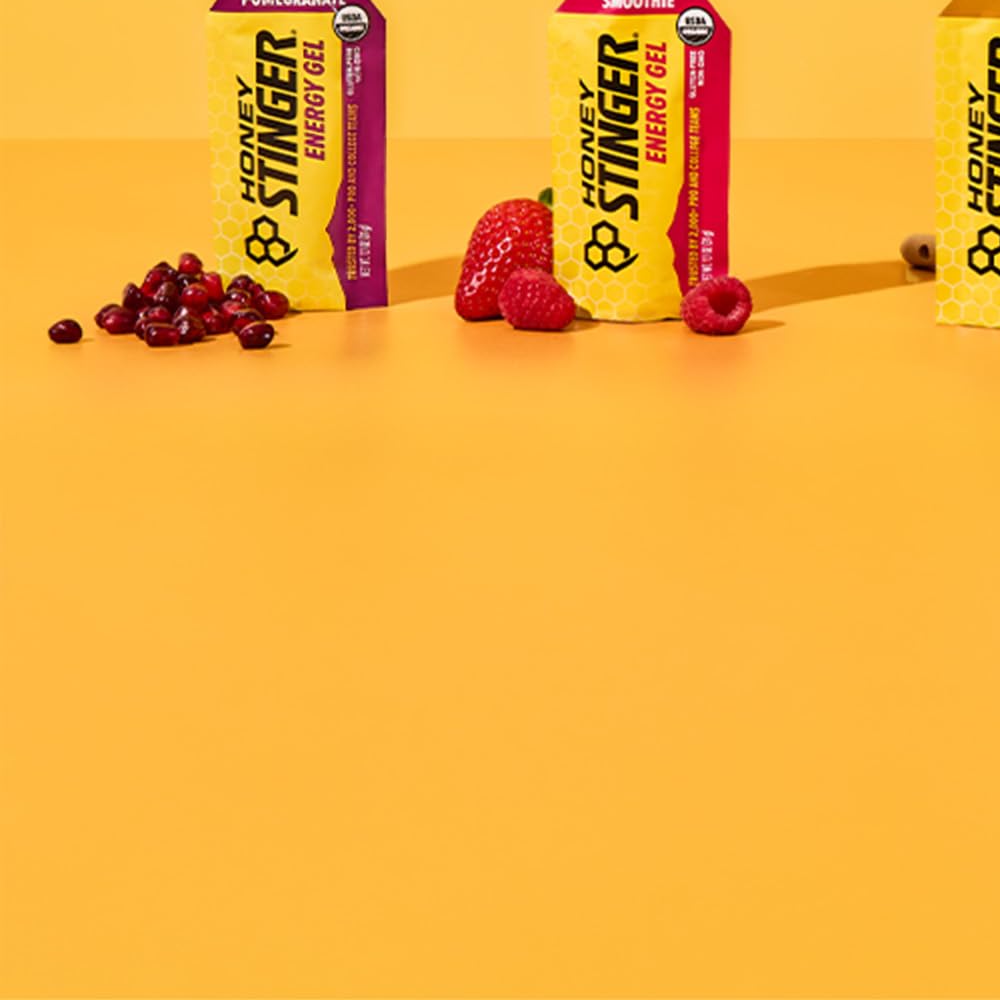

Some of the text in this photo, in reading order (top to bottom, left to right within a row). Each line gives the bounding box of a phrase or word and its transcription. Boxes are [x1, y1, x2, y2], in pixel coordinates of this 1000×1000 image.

[236, 74, 256, 204] HONEY
[255, 29, 299, 217] STINGER
[303, 39, 325, 161] ENERGY GEL
[579, 79, 596, 208] HONEY
[598, 33, 639, 221] STINGER
[645, 42, 667, 164] ENERGY GEL
[967, 81, 985, 212] HONEY
